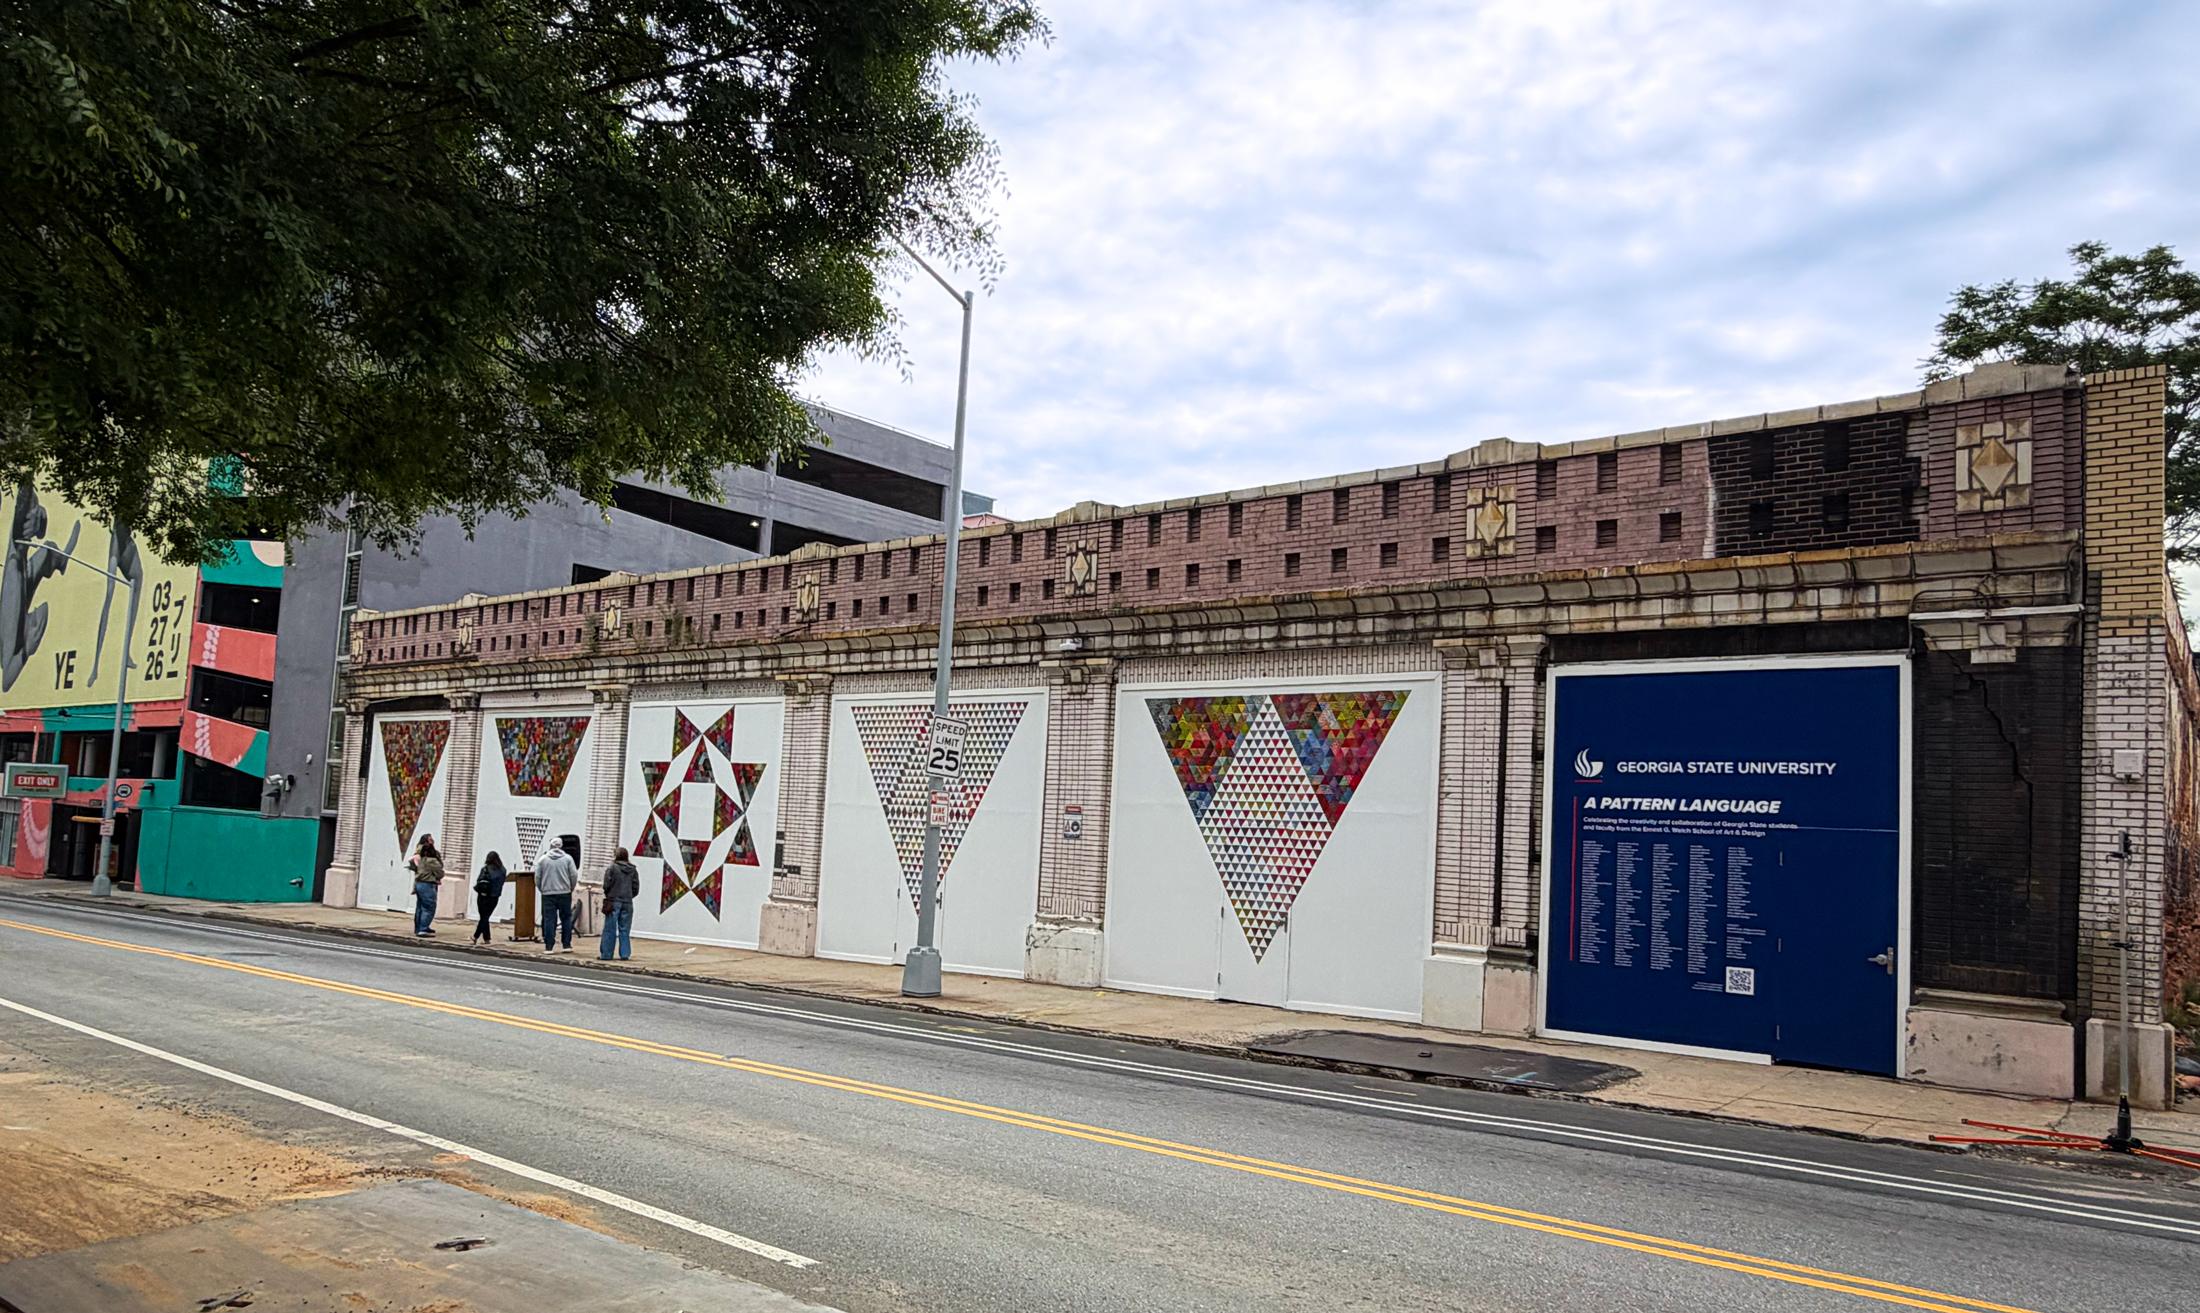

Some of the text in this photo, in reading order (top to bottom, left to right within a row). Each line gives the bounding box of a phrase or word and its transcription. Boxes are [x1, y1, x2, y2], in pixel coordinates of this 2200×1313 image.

[153, 580, 172, 613] 03
[148, 615, 169, 647] 27
[55, 650, 77, 690] YE
[144, 650, 164, 681] 26
[935, 722, 965, 736] SPEED
[935, 736, 960, 748] LIMIT
[929, 747, 960, 772] 25
[1616, 761, 1838, 776] GEORGIA STATE UNIVERSITY
[18, 775, 56, 787] EXIT ONLY
[1584, 797, 1782, 815] A PATTERN LANGUAGE
[1583, 816, 1618, 825] Celebrating
[1629, 818, 1657, 826] creativity
[1671, 819, 1713, 827] collaboration
[1721, 821, 1748, 829] Georgia
[1595, 824, 1615, 833] faculty
[1671, 826, 1692, 834] Welch
[1692, 827, 1715, 835] School
[1723, 828, 1734, 836] Art
[1741, 829, 1766, 838] Design
